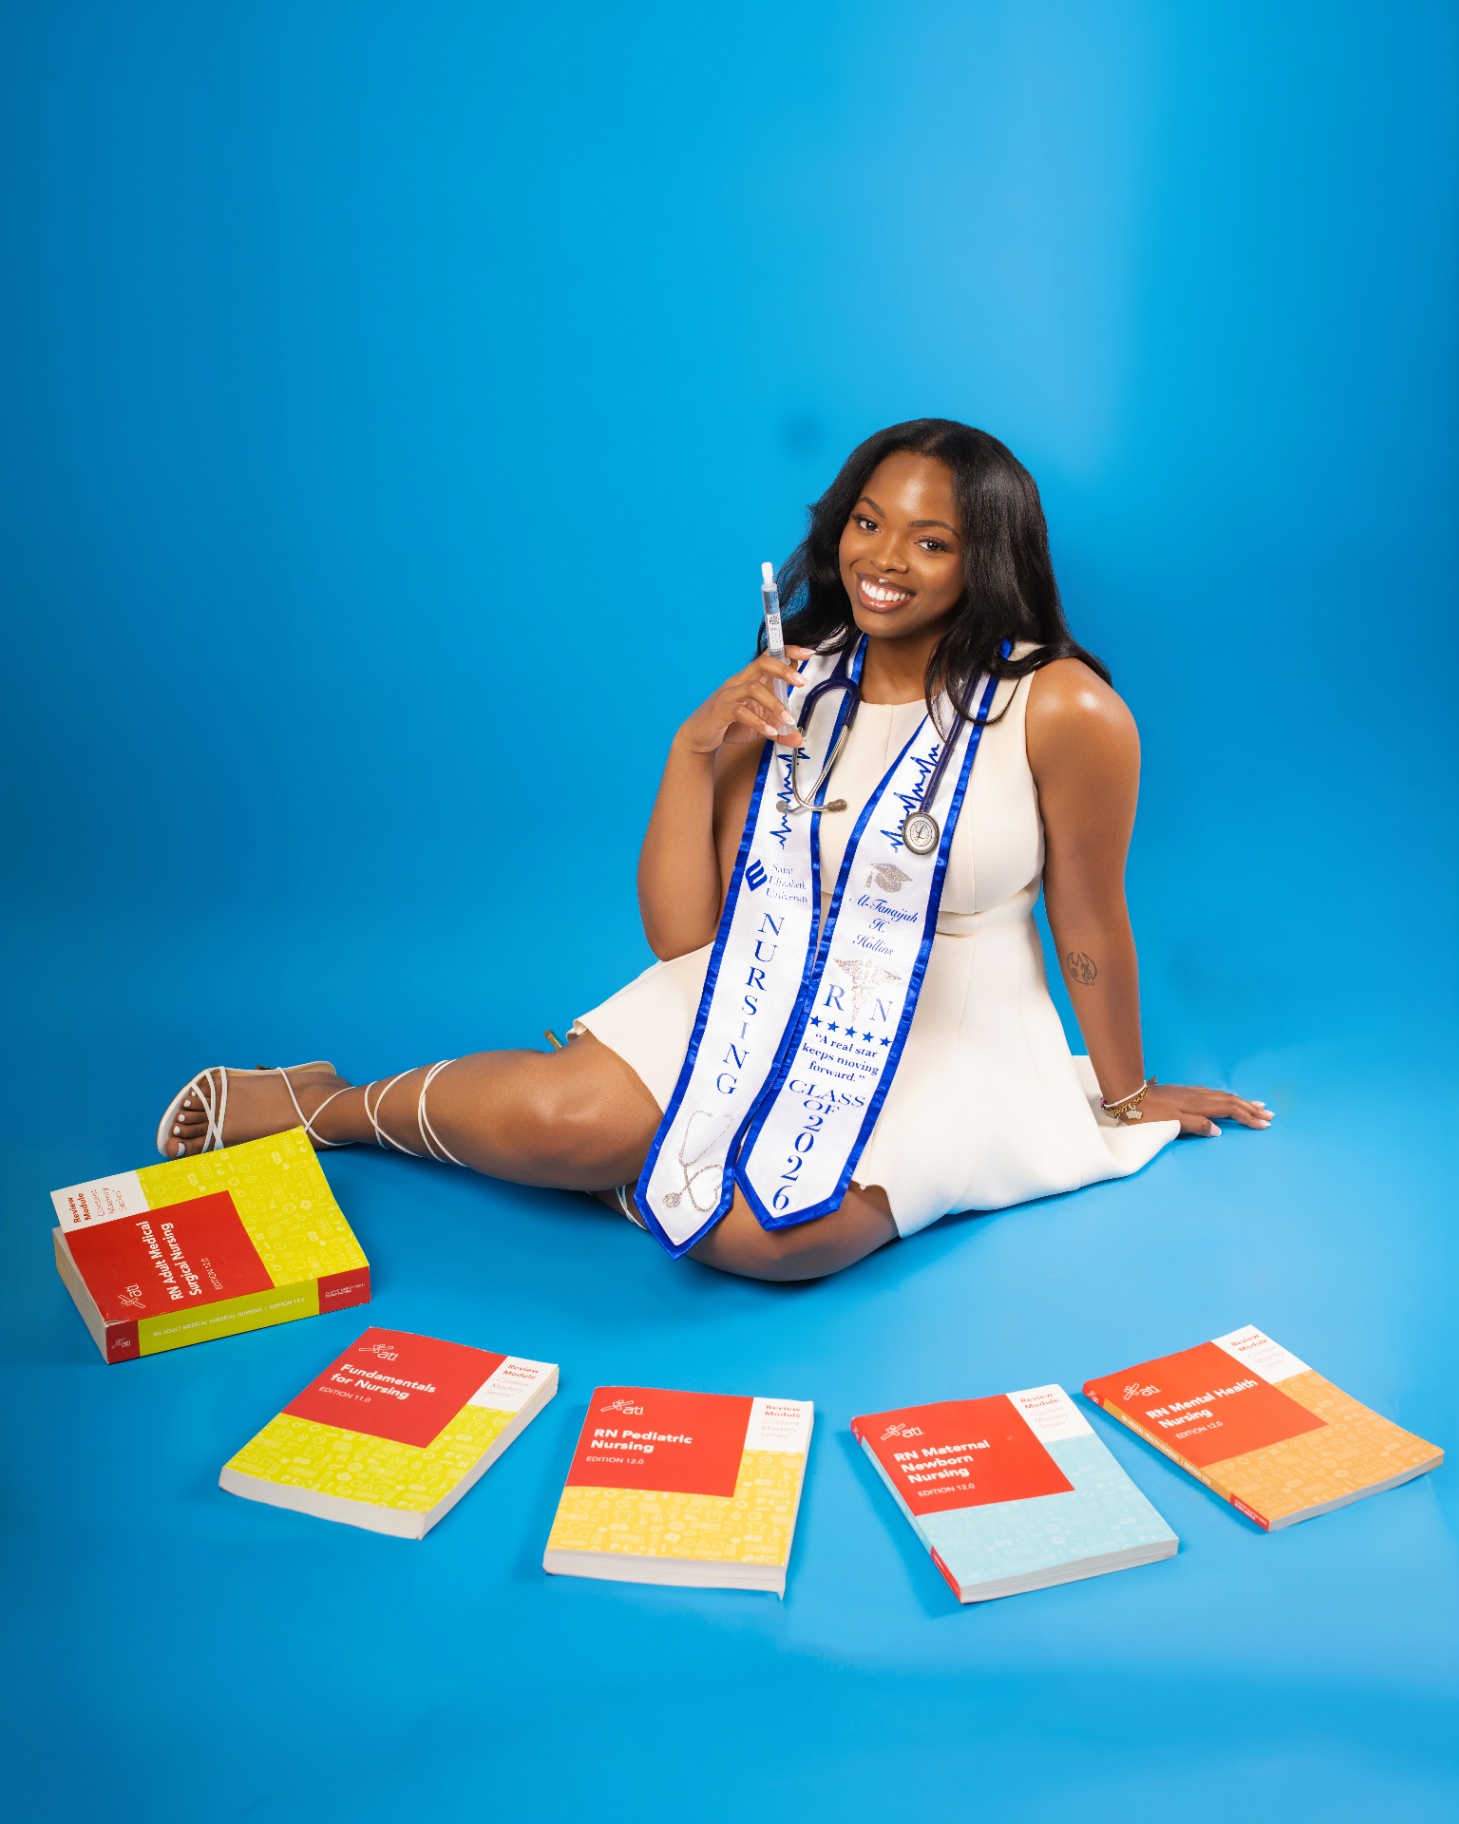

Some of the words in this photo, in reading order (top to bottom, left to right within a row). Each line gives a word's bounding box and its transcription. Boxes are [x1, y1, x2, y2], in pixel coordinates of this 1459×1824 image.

[853, 934, 894, 956] Hollins
[830, 1040, 853, 1053] real
[855, 1047, 878, 1059] star
[802, 1043, 835, 1062] keeps
[837, 1055, 880, 1076] moving
[788, 1079, 866, 1108] CLASS
[803, 1100, 840, 1115] OF
[67, 1197, 81, 1224] Review
[77, 1192, 92, 1221] Module
[135, 1220, 163, 1260] Medical
[160, 1222, 185, 1262] Nursing
[154, 1259, 177, 1284] Adult
[174, 1261, 203, 1297] Surgical
[166, 1285, 184, 1301] RN
[163, 1325, 182, 1335] ADULT
[182, 1320, 207, 1330] MEDICAL
[209, 1314, 236, 1325] SURGICAL
[1230, 1334, 1259, 1347] Review
[340, 1363, 437, 1394] Fundamentals
[503, 1370, 536, 1380] Module
[507, 1364, 540, 1374] Review
[318, 1386, 354, 1399] EDITION
[354, 1395, 372, 1403] 11.0
[330, 1373, 351, 1385] for
[354, 1378, 410, 1401] Nursing
[1019, 1393, 1053, 1403] Review
[1024, 1398, 1059, 1409] Module
[1146, 1407, 1171, 1420] RN
[1169, 1393, 1216, 1412] Mental
[1213, 1379, 1259, 1398] Health
[765, 1404, 801, 1412] Review
[1158, 1408, 1213, 1429] Nursing
[594, 1429, 618, 1438] RN
[621, 1429, 693, 1444] Pediatric
[1175, 1425, 1207, 1439] EDITION
[1207, 1420, 1223, 1430] 12.0
[590, 1440, 654, 1453] Nursing
[893, 1451, 919, 1462] RN
[921, 1439, 991, 1458] Maternal
[586, 1455, 624, 1463] EDITION
[626, 1457, 644, 1465] 12.0
[900, 1454, 974, 1473] Newborn
[908, 1467, 970, 1484] Nursing
[917, 1486, 955, 1498] EDITION
[956, 1483, 975, 1491] 12.0
